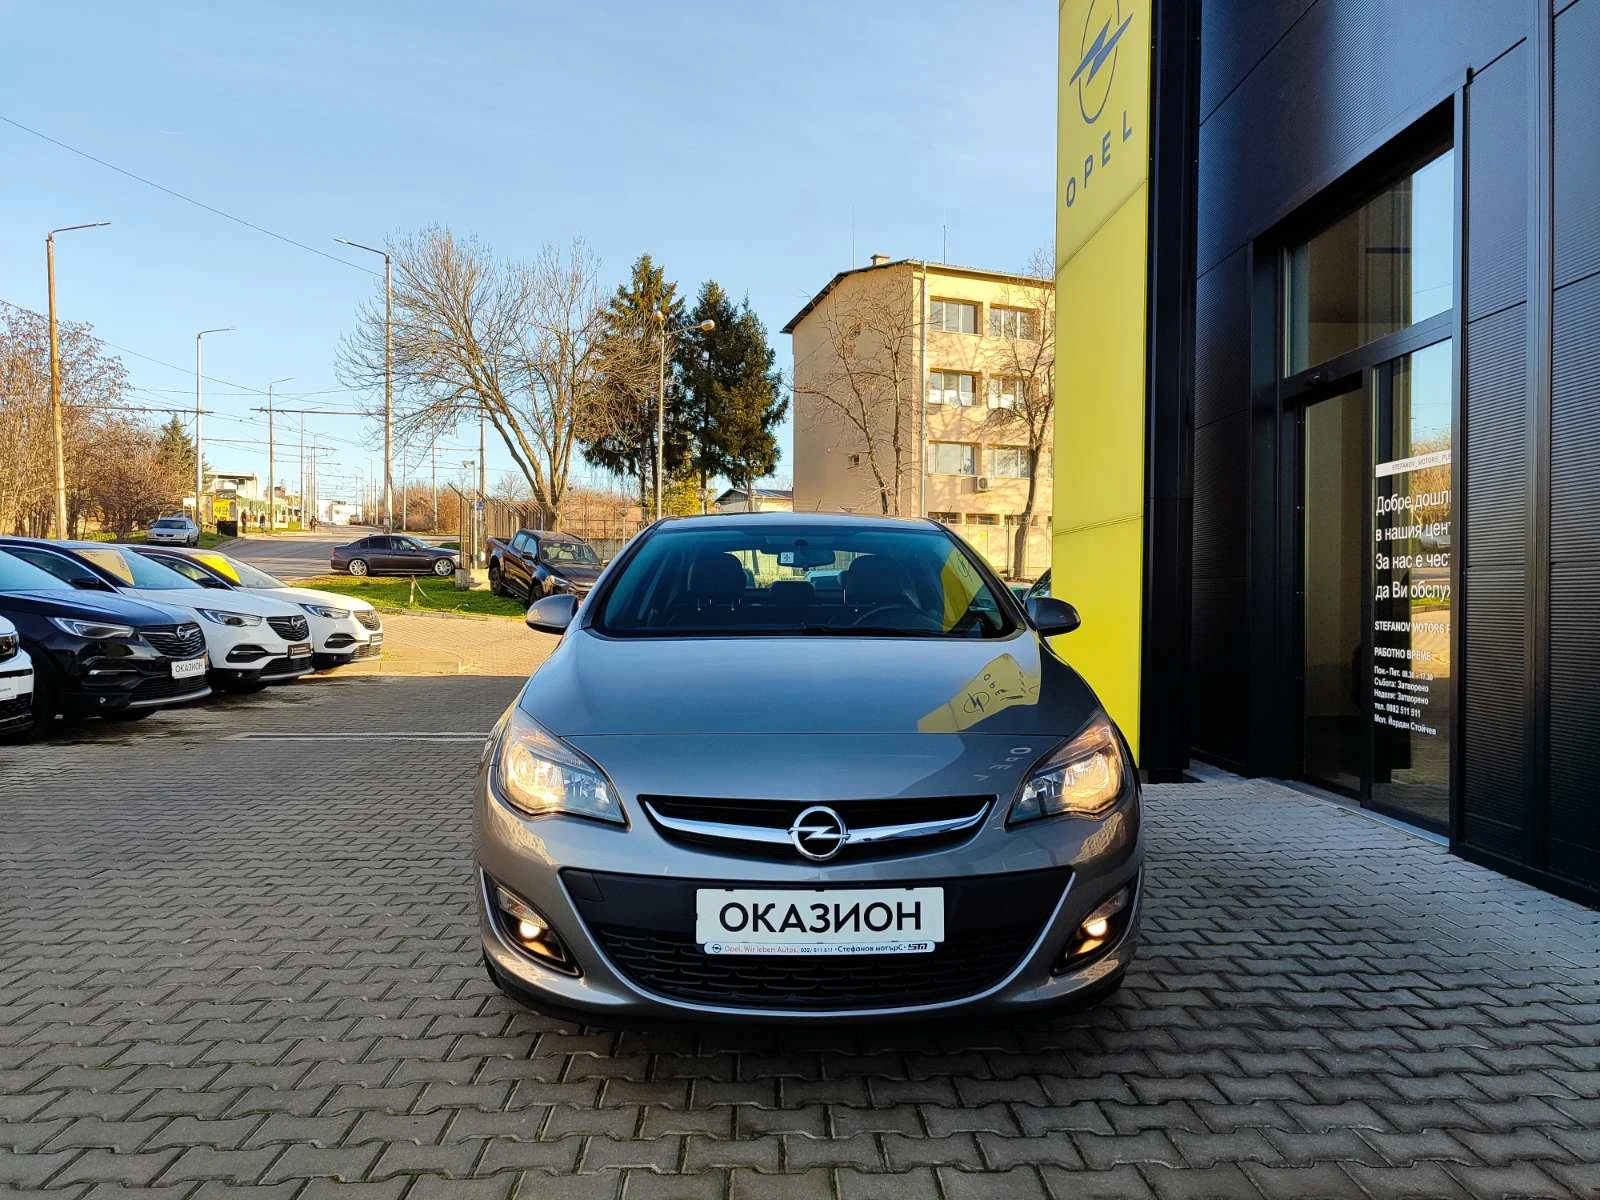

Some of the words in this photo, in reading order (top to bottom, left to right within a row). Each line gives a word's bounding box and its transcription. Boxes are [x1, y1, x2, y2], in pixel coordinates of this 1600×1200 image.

[1066, 110, 1132, 207] OPEL
[1376, 493, 1412, 516] Добре
[1376, 528, 1382, 541] в
[1384, 525, 1422, 541] нашия
[1376, 553, 1389, 570] За
[1392, 555, 1412, 569] нас
[1416, 556, 1422, 568] е
[1376, 584, 1390, 601] да
[1392, 581, 1408, 598] Ви
[1374, 620, 1410, 632] STEFANOV
[1413, 622, 1444, 632] MOTORS
[1374, 647, 1406, 658] РАБОТНО
[1400, 706, 1410, 716] 511
[719, 901, 921, 933] ОКАЗИОН
